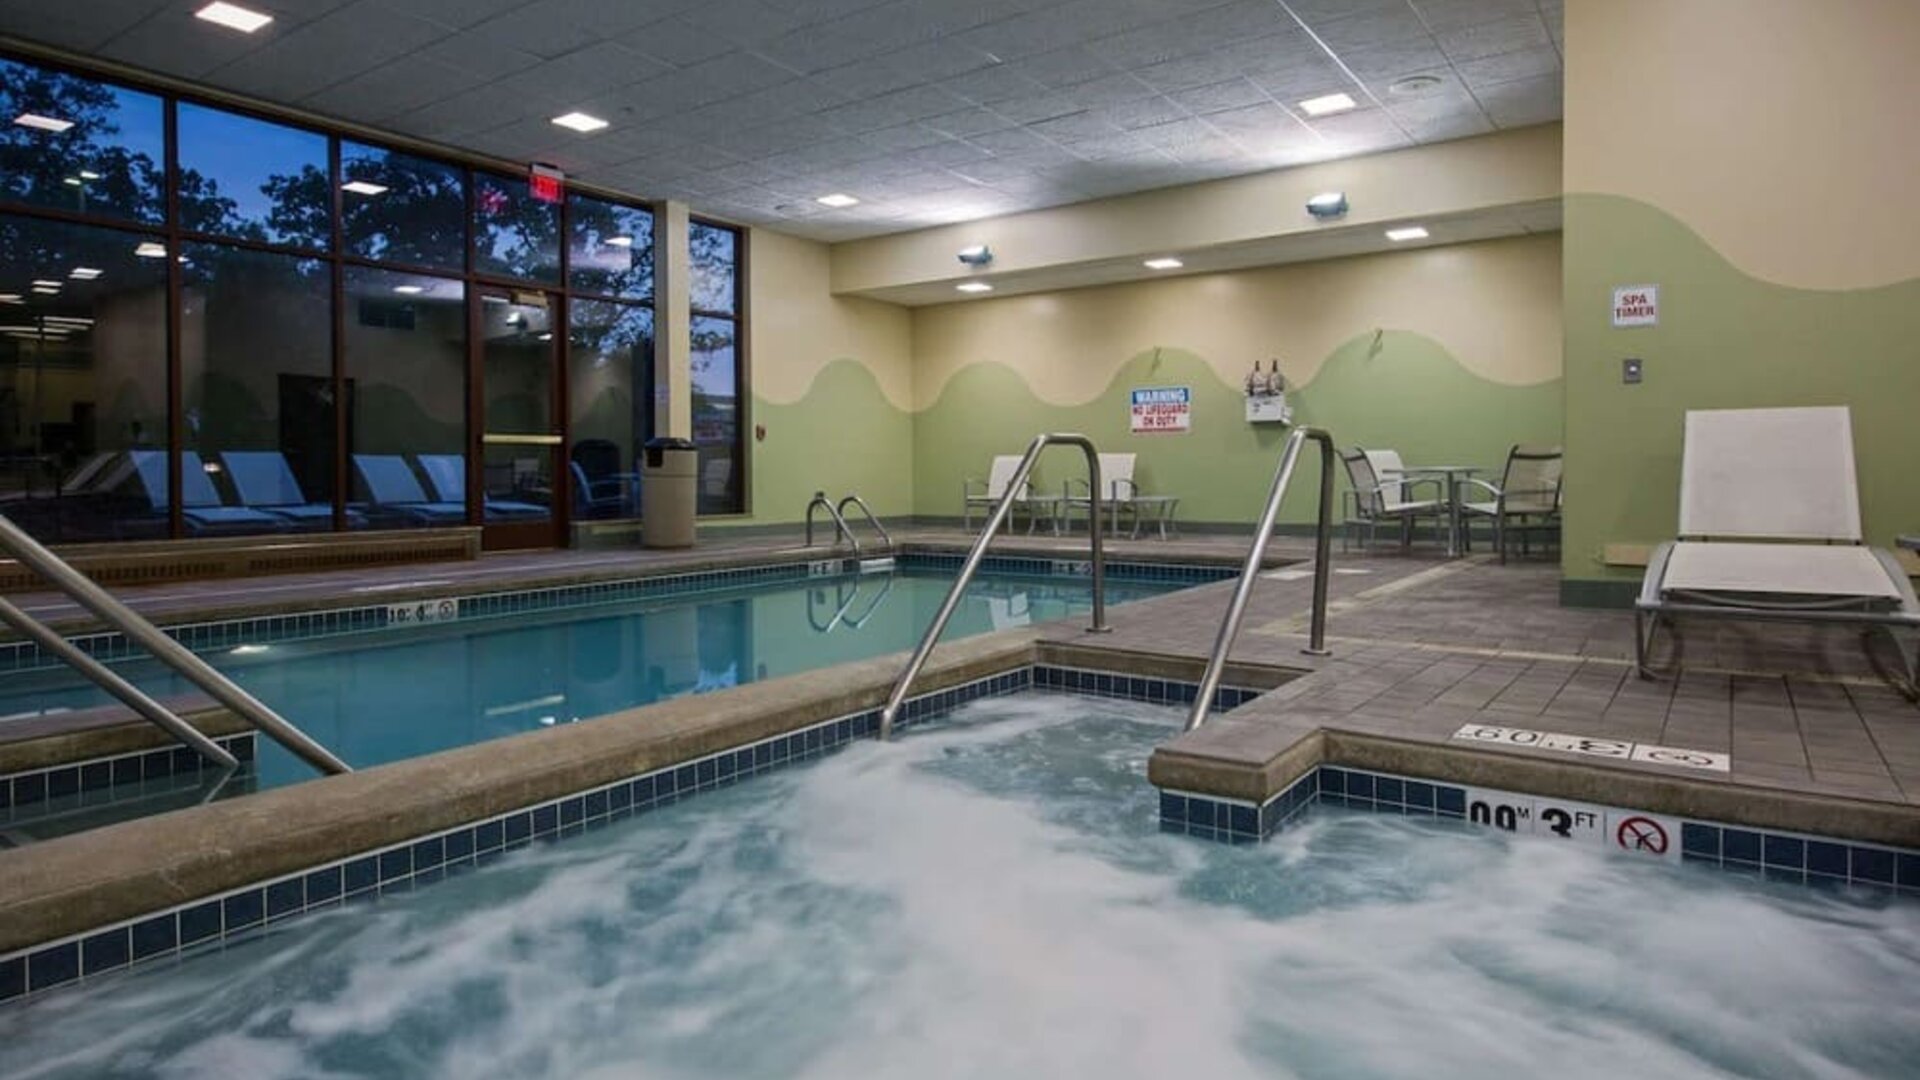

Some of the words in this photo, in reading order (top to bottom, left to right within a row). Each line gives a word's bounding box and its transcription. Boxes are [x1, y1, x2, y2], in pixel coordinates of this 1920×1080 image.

[1622, 294, 1647, 305] SPA
[1615, 305, 1654, 318] TIMER
[1135, 389, 1185, 403] WARNING
[1132, 405, 1143, 415] NO
[1146, 403, 1187, 415] LIFEGUARD
[1143, 416, 1154, 426] ON
[1156, 416, 1177, 426] DUTY
